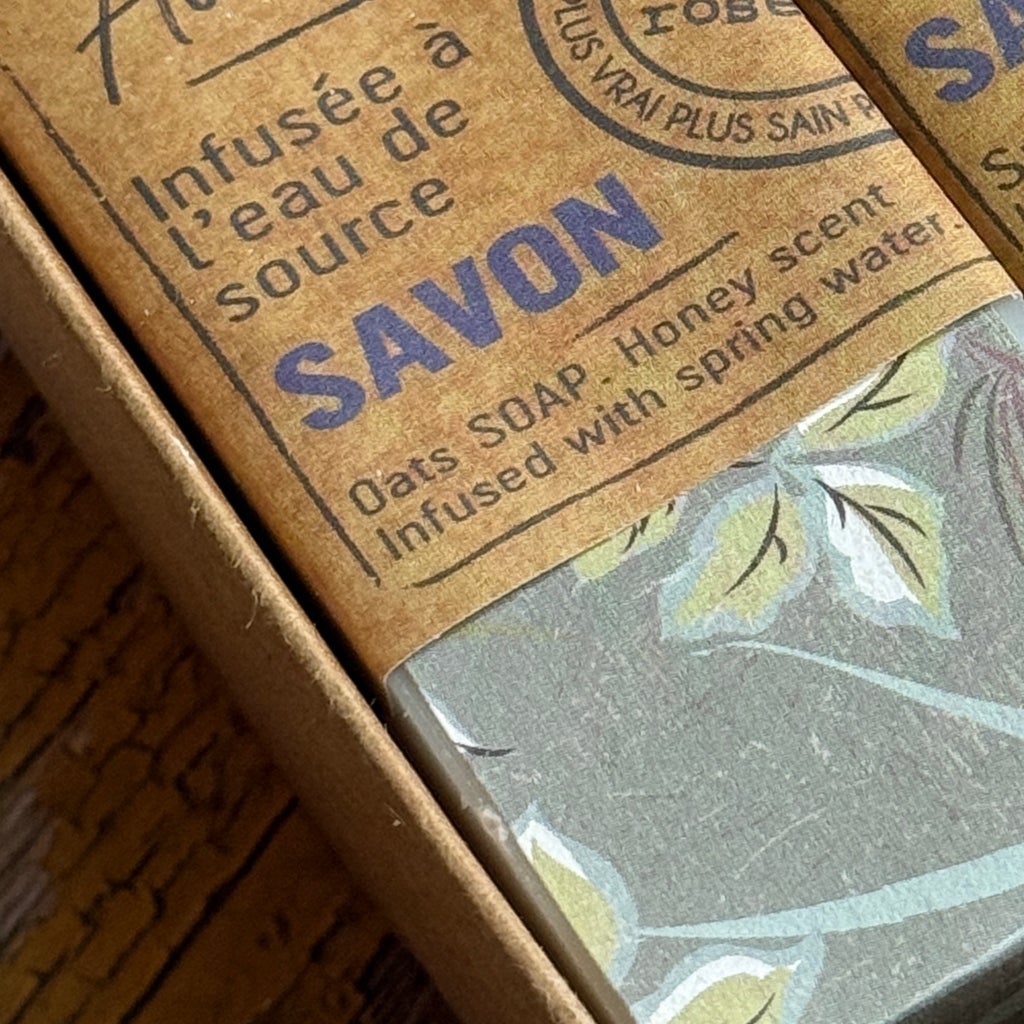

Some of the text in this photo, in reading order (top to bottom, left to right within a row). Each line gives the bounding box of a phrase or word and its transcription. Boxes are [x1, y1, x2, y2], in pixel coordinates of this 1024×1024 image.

[131, 22, 473, 223] Infusée à
[381, 97, 471, 162] de
[591, 53, 666, 122] VRAI
[664, 101, 755, 144] PLUS
[767, 99, 851, 143] SAIN
[215, 176, 456, 323] source
[272, 173, 666, 431] SAVON
[349, 183, 896, 517] Oats SOAP Honey scent
[375, 440, 559, 562] Infused
[564, 382, 668, 455] with
[675, 291, 819, 392] spring
